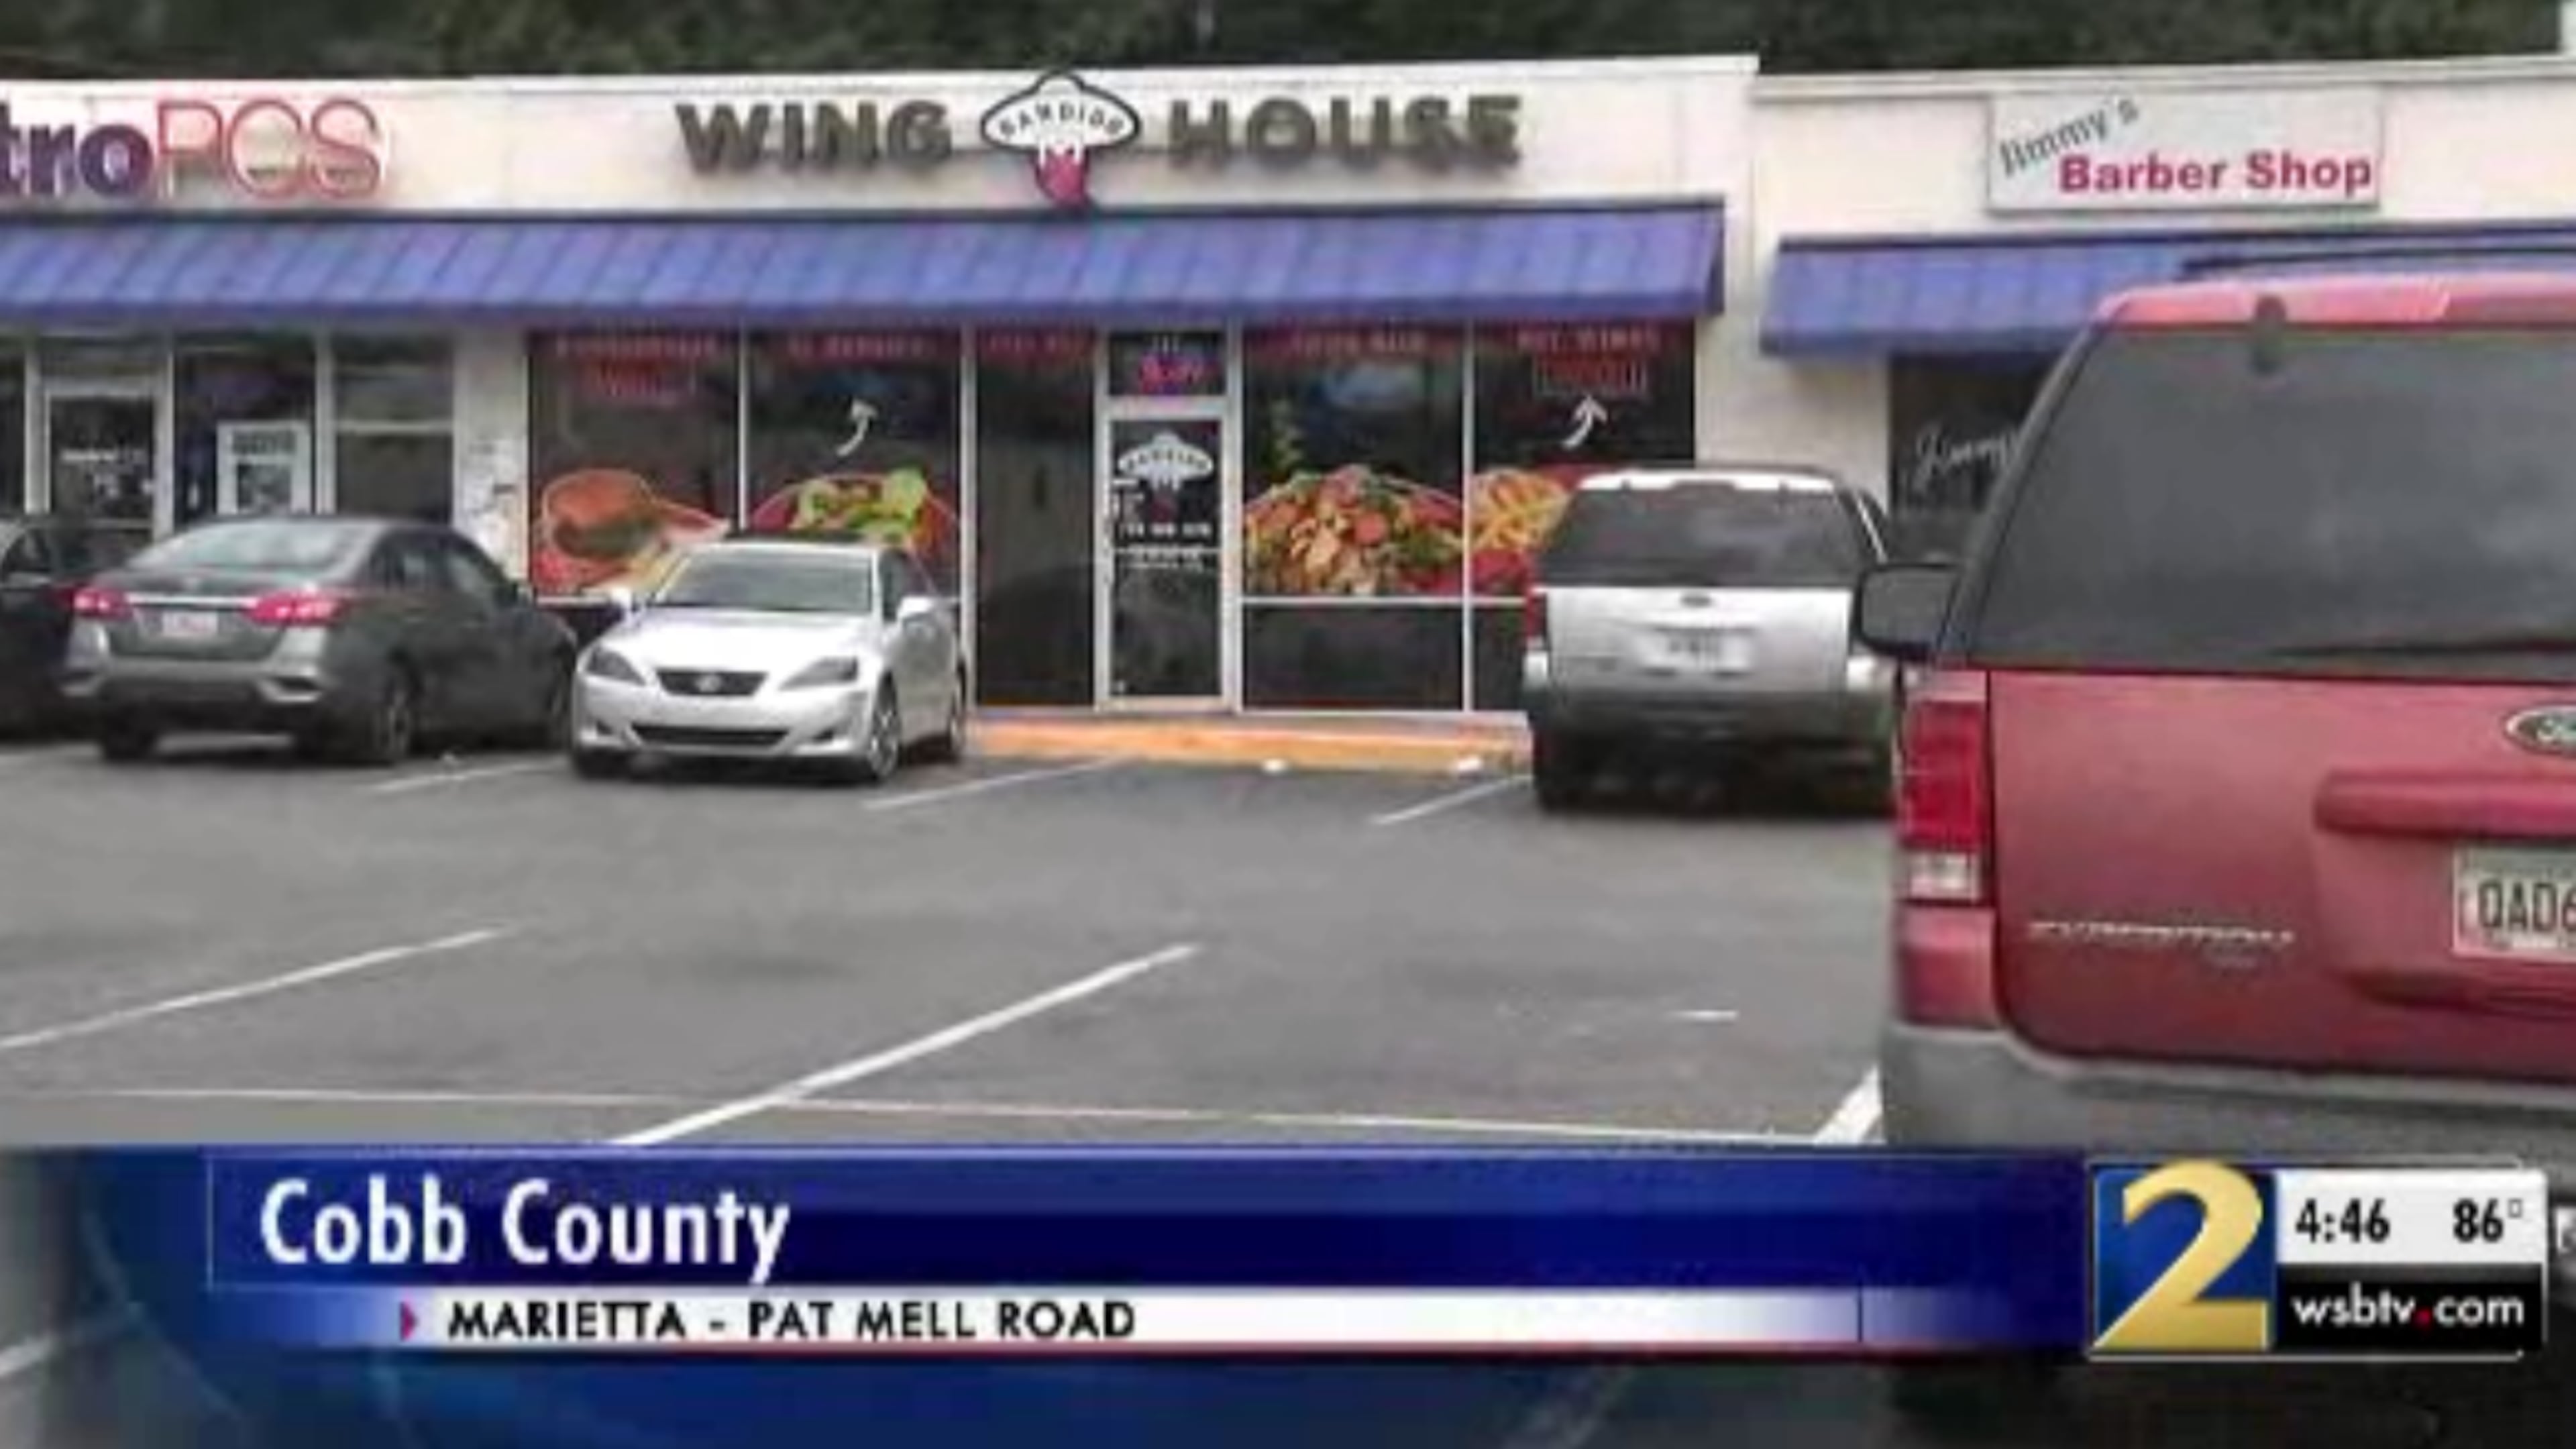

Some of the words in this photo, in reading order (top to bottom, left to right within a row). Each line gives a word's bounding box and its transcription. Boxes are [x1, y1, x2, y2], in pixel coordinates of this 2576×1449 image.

[674, 99, 951, 176] WING
[1169, 94, 1523, 176] HOUSE
[2060, 151, 2229, 192] Barber
[2245, 149, 2372, 199] Shop
